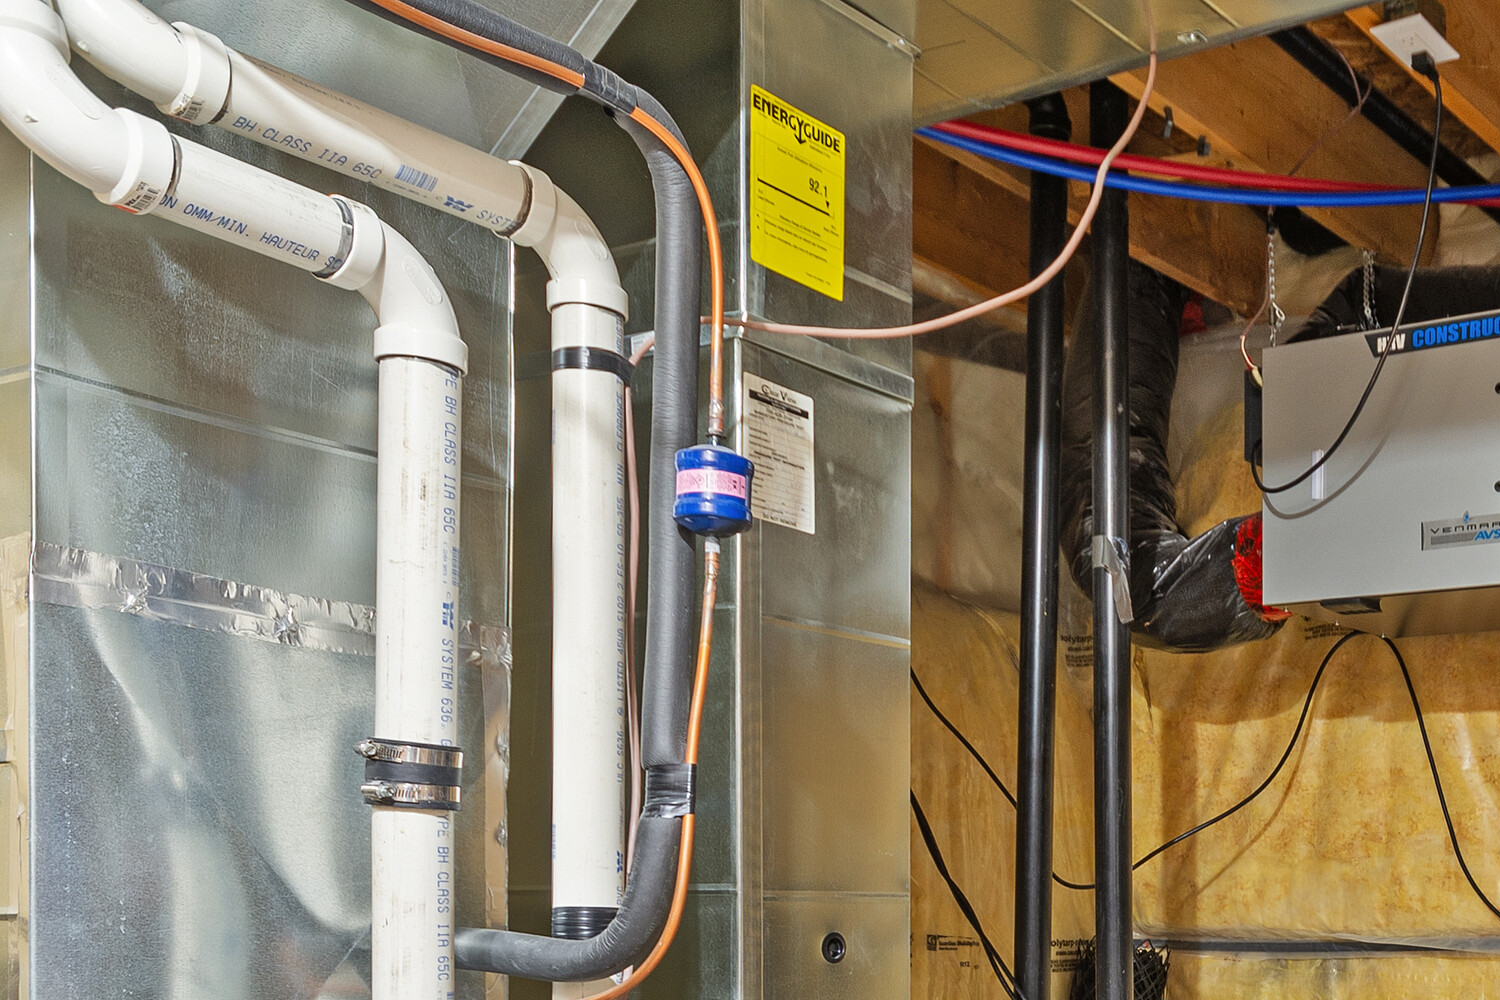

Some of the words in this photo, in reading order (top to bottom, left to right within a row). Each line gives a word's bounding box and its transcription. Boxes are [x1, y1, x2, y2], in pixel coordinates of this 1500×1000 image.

[232, 116, 258, 132] BH
[262, 127, 313, 154] CLASS
[753, 93, 841, 153] ENERGYGUIDE
[808, 177, 828, 198] 92.1
[259, 231, 320, 262] HAUTEUR
[444, 396, 457, 416] BH
[444, 422, 457, 466] CLASS
[441, 638, 453, 690] SYSTEM
[437, 846, 449, 864] BH
[437, 871, 449, 913] CLASS
